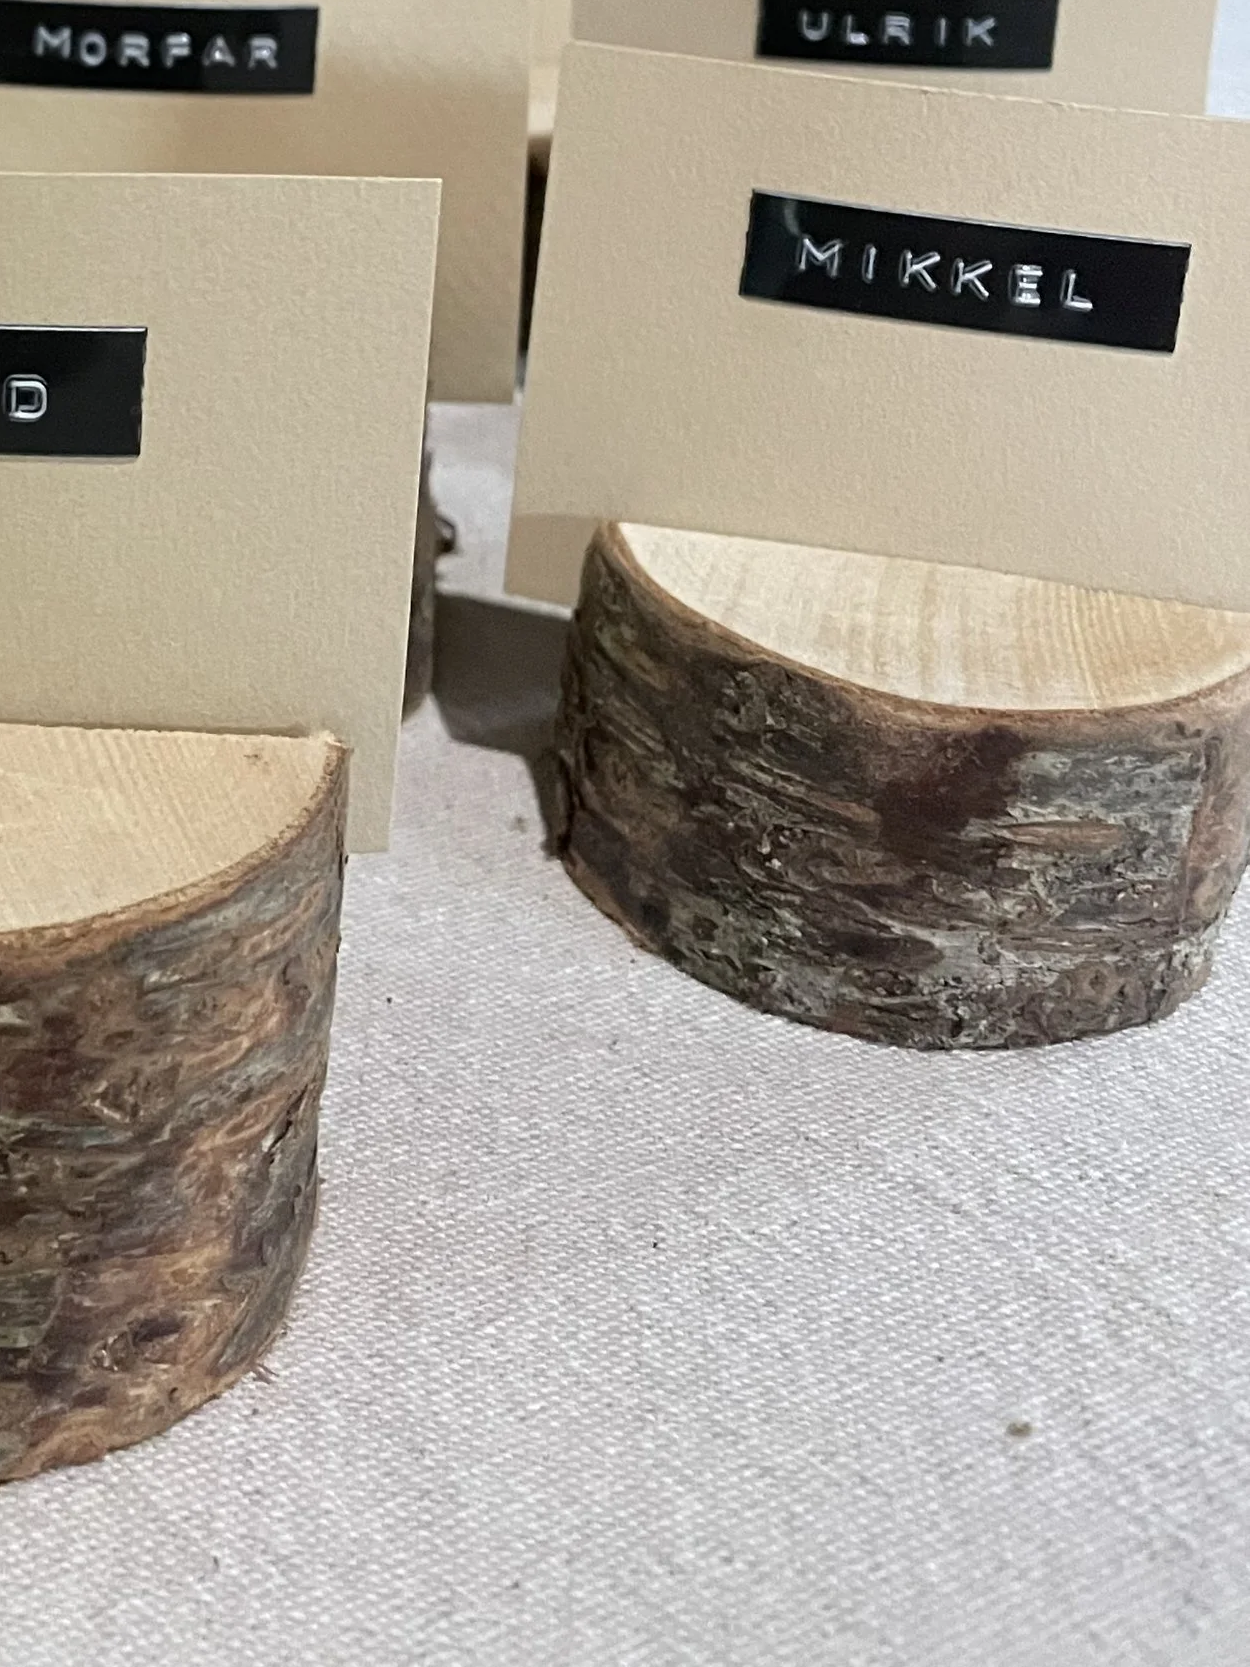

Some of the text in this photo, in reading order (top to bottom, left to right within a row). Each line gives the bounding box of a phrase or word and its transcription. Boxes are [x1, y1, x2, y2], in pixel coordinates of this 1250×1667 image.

[33, 25, 278, 70] MORFAR
[800, 11, 996, 47] ULRIK
[797, 237, 1094, 311] MIKKEL
